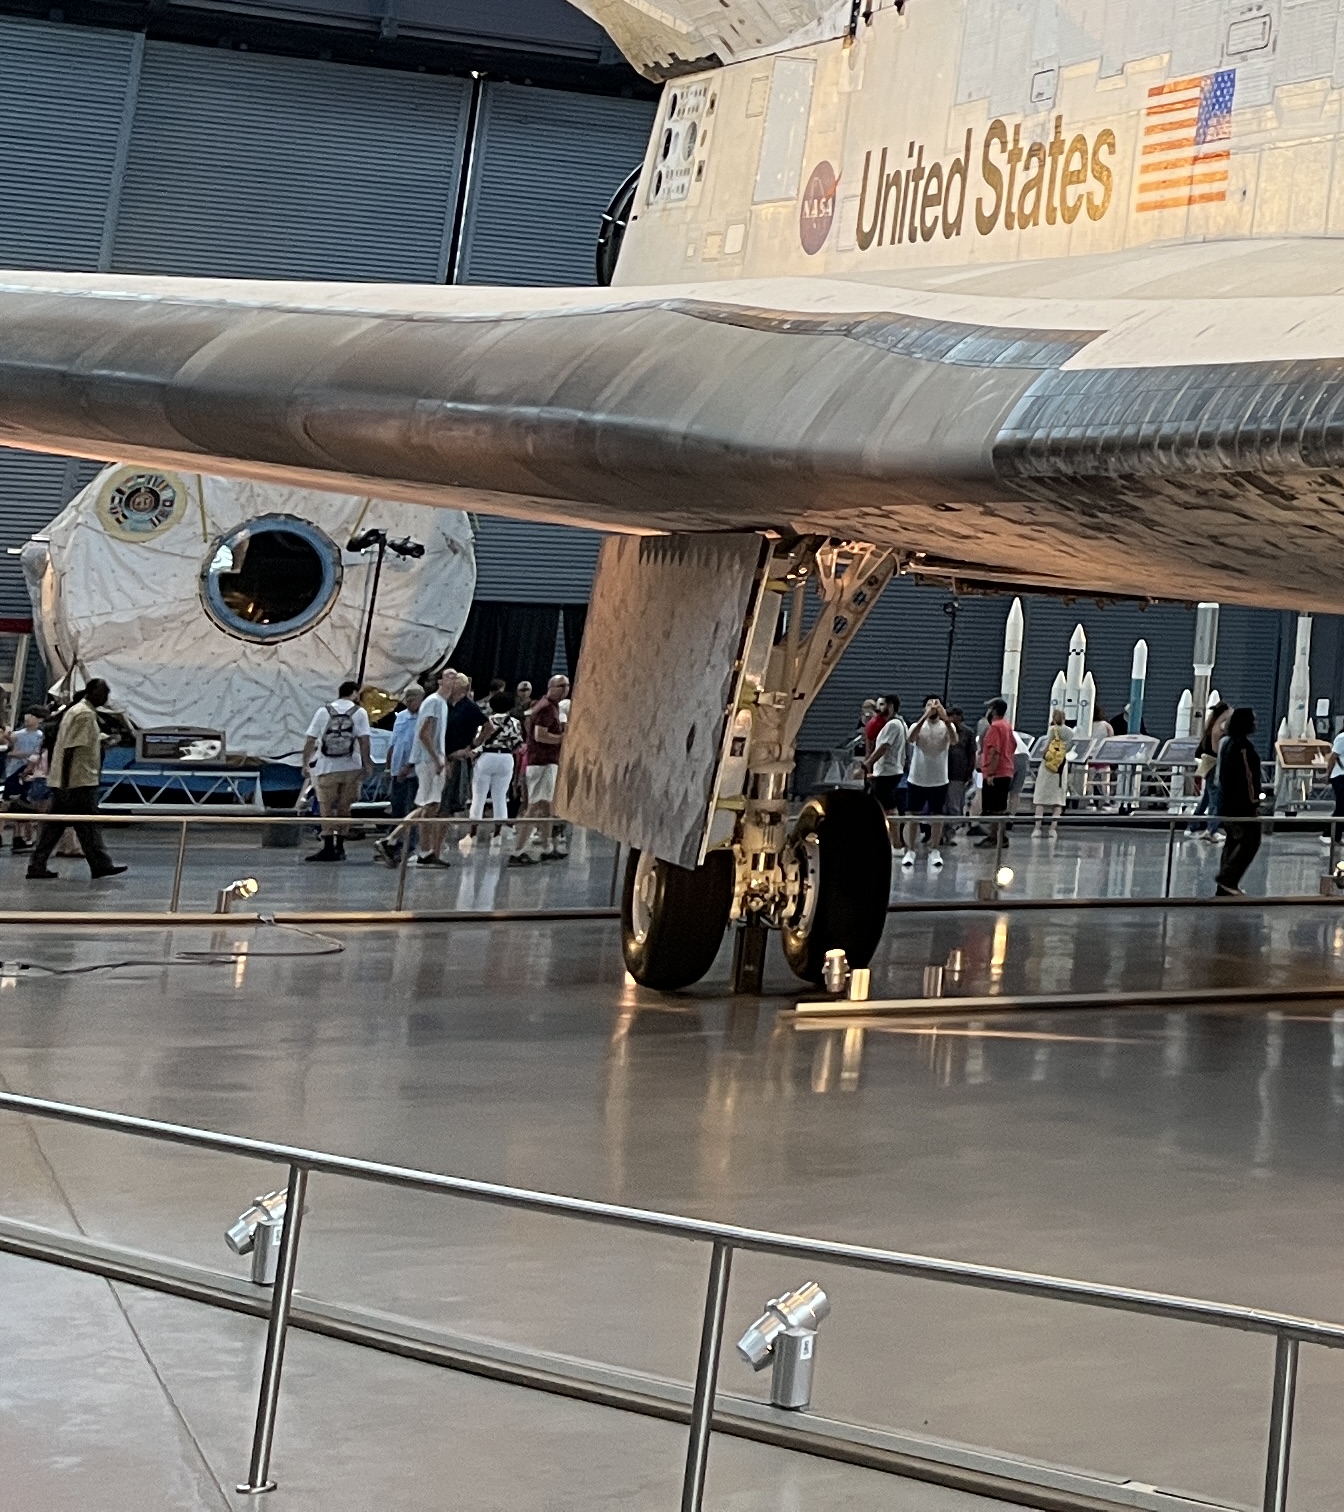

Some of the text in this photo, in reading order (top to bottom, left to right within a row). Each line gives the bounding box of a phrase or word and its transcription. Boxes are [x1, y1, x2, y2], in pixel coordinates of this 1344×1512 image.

[802, 197, 833, 218] NASA
[856, 115, 1116, 251] United States
